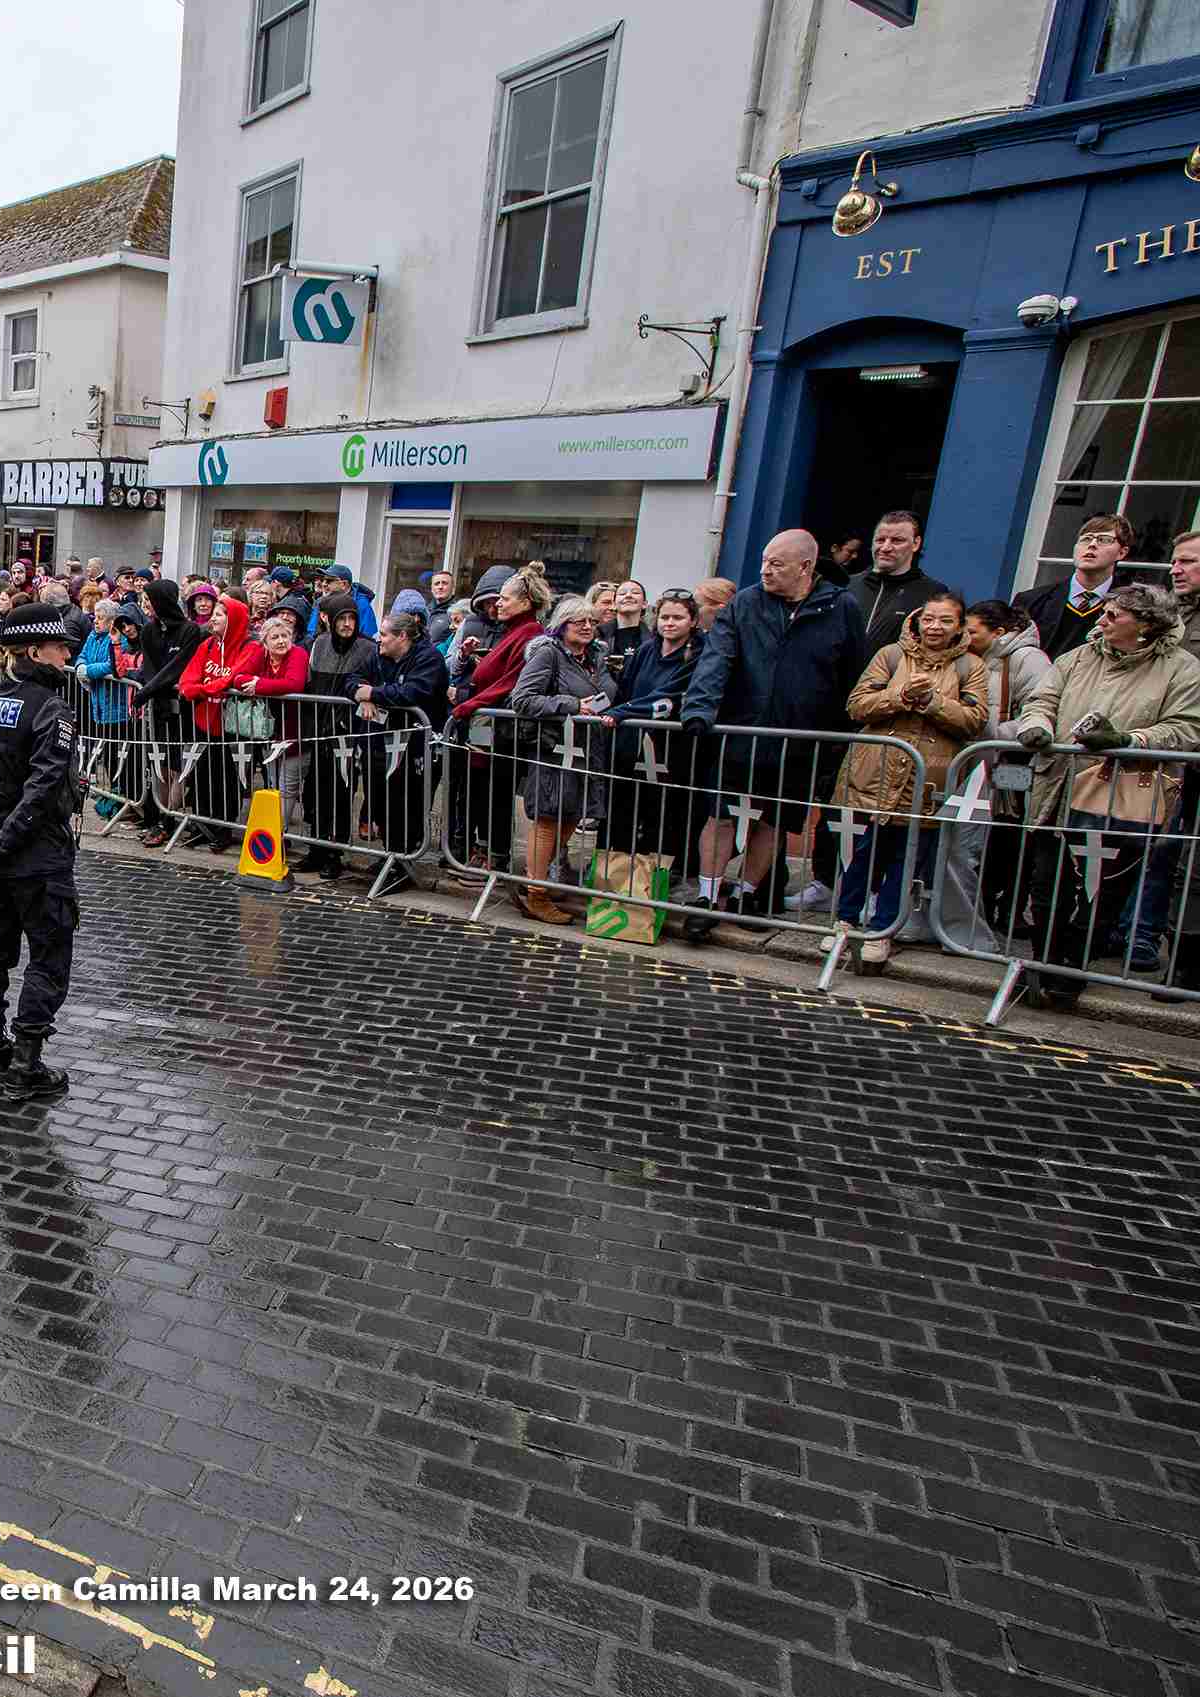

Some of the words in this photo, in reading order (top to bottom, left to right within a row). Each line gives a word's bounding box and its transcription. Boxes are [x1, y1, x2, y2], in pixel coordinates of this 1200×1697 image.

[853, 248, 921, 280] EST
[371, 440, 467, 467] Millerson
[558, 436, 689, 453] www.millerson.com
[2, 461, 104, 505] BARBER
